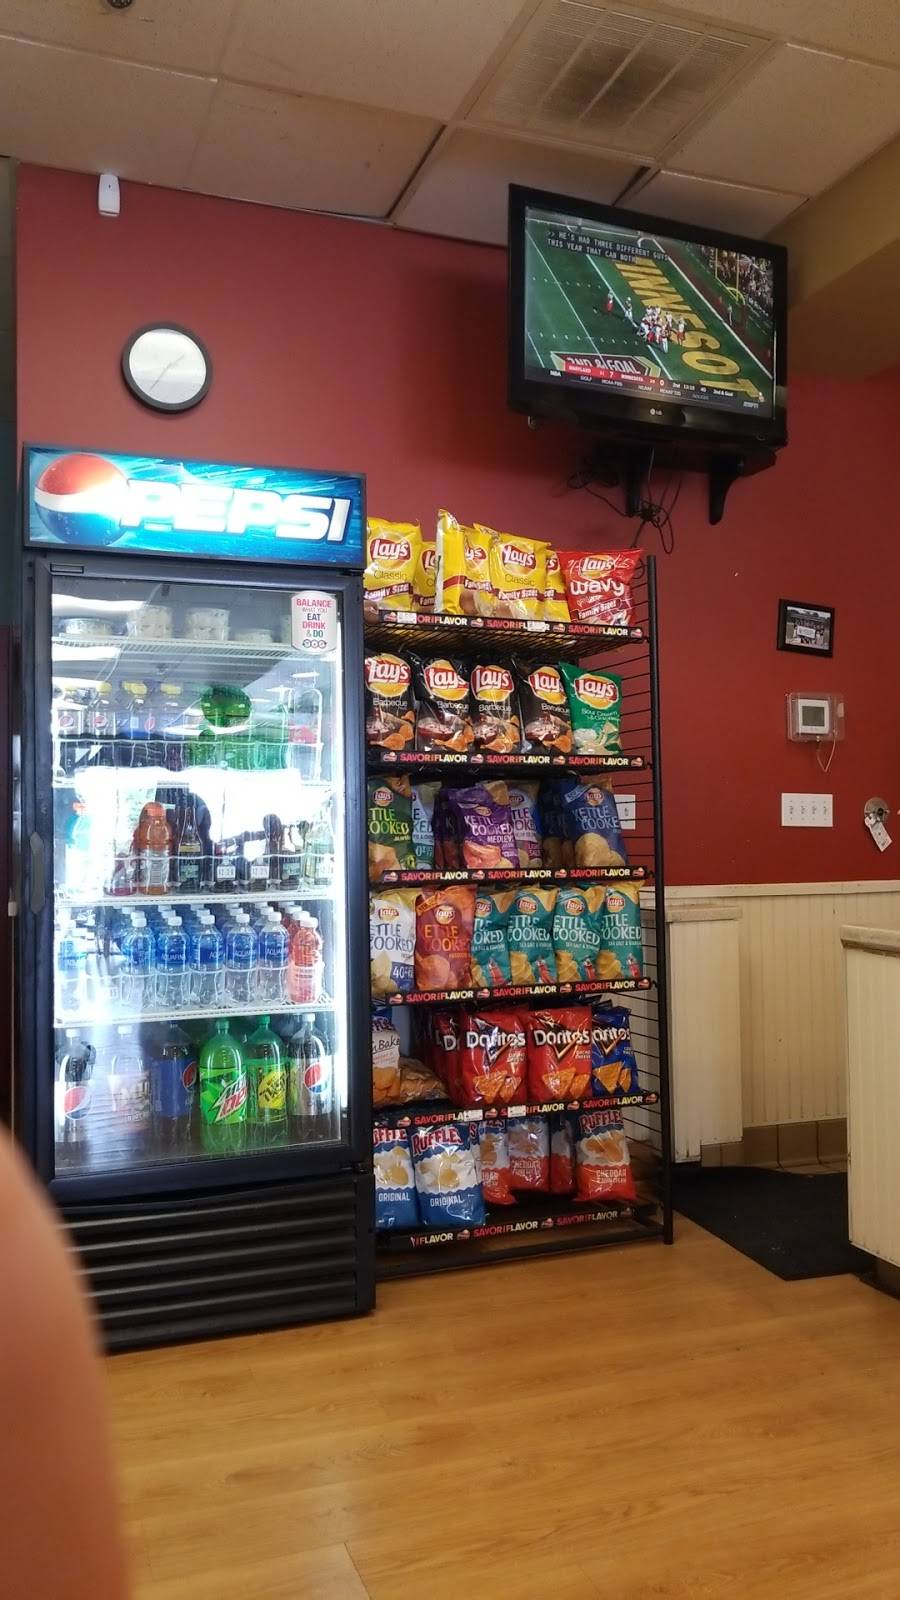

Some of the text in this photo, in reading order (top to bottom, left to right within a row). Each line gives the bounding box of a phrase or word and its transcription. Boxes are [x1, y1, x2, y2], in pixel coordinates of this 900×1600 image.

[548, 238, 563, 248] THIS
[566, 243, 582, 252] YEAR
[586, 247, 601, 255] THAT
[620, 254, 636, 263] BOTH
[558, 232, 575, 240] HE'S
[578, 236, 590, 244] HAD
[594, 239, 613, 250] THREE
[616, 244, 650, 256] DIFFERENT
[653, 252, 668, 261] GUYS
[606, 360, 641, 374] GOAL
[118, 478, 352, 542] PEPSI
[372, 538, 408, 560] Lay's
[502, 546, 535, 566] Lay's
[373, 570, 407, 580] Classic
[504, 574, 535, 586] Classic
[570, 578, 624, 596] wavy
[296, 598, 332, 608] BALANCE
[307, 613, 321, 621] EAT
[435, 616, 468, 626] FLAVOR
[302, 621, 326, 630] DRINK
[487, 620, 515, 629] SAVOR
[568, 625, 628, 636] SAVOR FLAVOR
[313, 630, 324, 638] DO
[367, 660, 409, 684] Lay's
[429, 668, 466, 690] Lay's
[476, 669, 510, 690] Lay's
[579, 680, 614, 698] Lay's
[372, 698, 408, 708] Barbecue
[437, 701, 469, 710] Barbecue
[478, 704, 512, 712] Barbecue
[400, 753, 468, 763] SAVOR FLAVOR
[519, 756, 550, 764] FLAVOR
[599, 758, 629, 766] FLAVOR
[369, 807, 397, 821] TTLE
[572, 805, 609, 822] KETTLE
[369, 821, 409, 835] OOKED
[582, 816, 620, 831] COOKE
[400, 871, 468, 880] SAVOR FLAVOR
[488, 870, 552, 879] SAVOR FLAVOR
[570, 868, 630, 878] SAVOR FLAVOR
[508, 915, 540, 929] ETTLE
[553, 915, 587, 930] ETTLE
[602, 913, 628, 927] TTLE
[370, 923, 402, 937] ETTLE
[424, 924, 458, 937] ETTLE
[602, 926, 641, 940] OOKED
[473, 930, 504, 944] OKED
[370, 936, 413, 952] OOKED
[493, 985, 557, 997] SAVOR FLAVOR
[575, 981, 636, 992] SAVOR FLAVOR
[406, 990, 474, 1002] SAVOR FLAVOR
[466, 1031, 526, 1048] Doritos
[533, 1029, 590, 1046] Doritos
[533, 1103, 564, 1112] FLAVOR
[583, 1096, 643, 1109] SAVOR FLAVOR
[414, 1112, 464, 1125] SAVOR FLA
[596, 1168, 627, 1177] CHEDDAR
[378, 1192, 410, 1202] ORIGINAL
[430, 1195, 464, 1207] ORIGINAL
[588, 1210, 618, 1221] FLAVOR
[474, 1221, 538, 1238] SAVOR FLAVOR
[420, 1232, 453, 1245] FLAVOR
